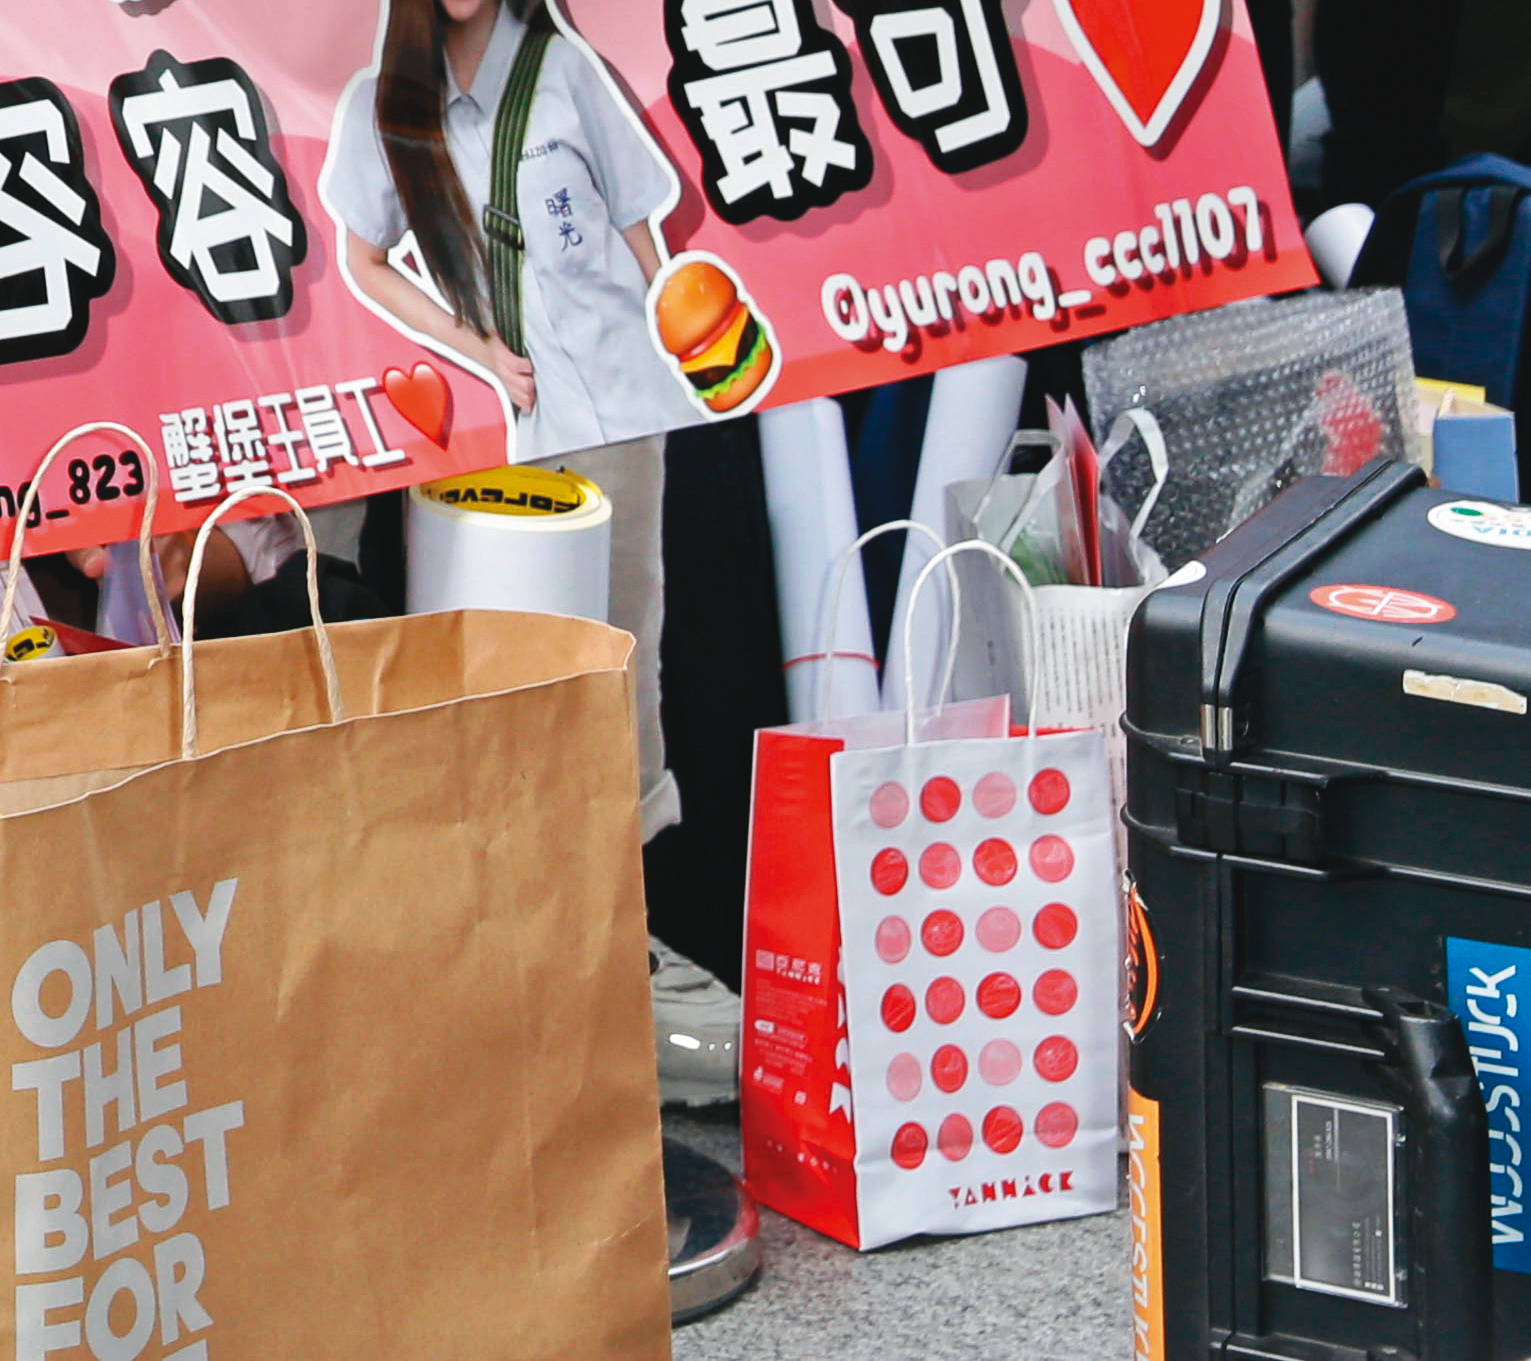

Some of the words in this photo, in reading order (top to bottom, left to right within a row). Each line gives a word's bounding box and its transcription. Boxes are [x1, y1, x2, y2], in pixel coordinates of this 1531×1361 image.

[820, 184, 1272, 351] @yurong_ccc1107
[10, 878, 240, 1049] ONLY
[11, 1005, 186, 1164] THE
[14, 1101, 245, 1276] BEST
[14, 1231, 214, 1361] FOR
